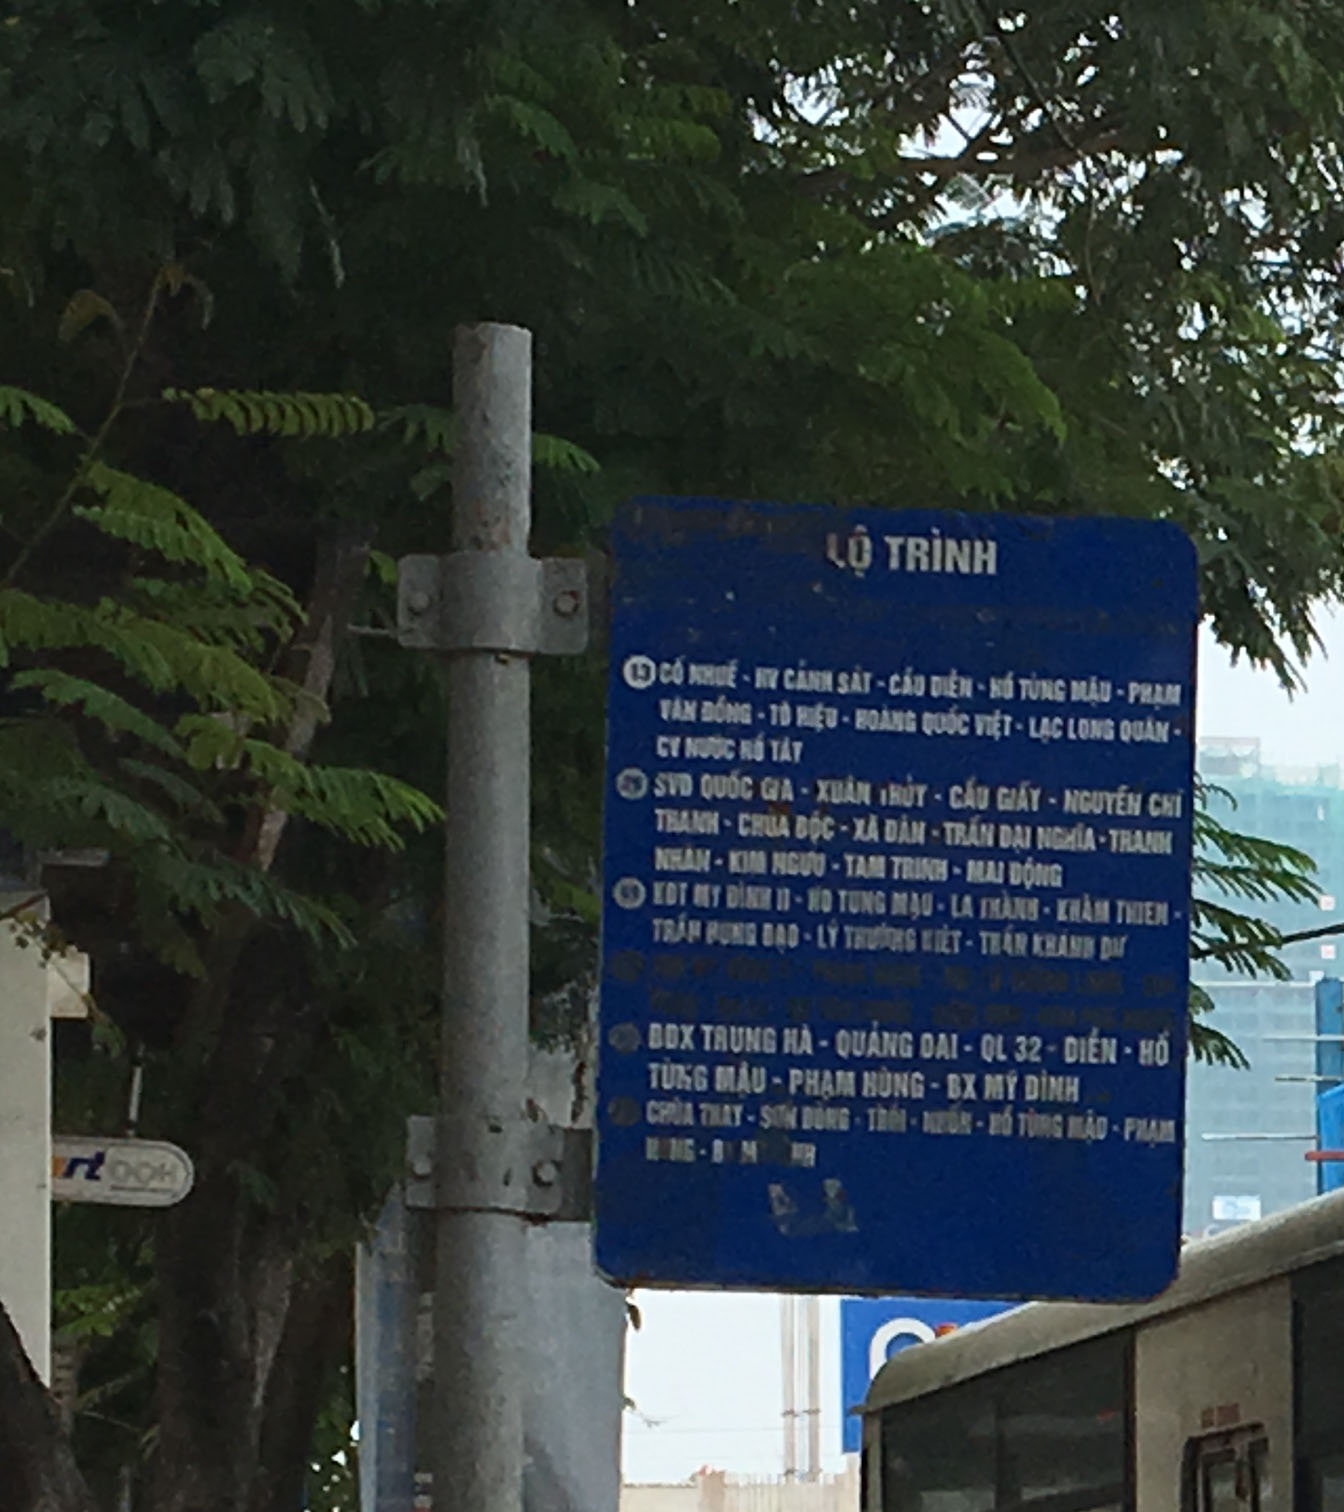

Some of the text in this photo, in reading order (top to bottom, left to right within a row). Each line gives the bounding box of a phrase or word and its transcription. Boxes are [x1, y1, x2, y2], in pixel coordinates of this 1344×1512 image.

[884, 528, 996, 575] TRÌNH
[1068, 718, 1114, 740] LONG
[701, 1024, 776, 1053] TRUNG
[981, 1034, 1007, 1062] QL
[1015, 1036, 1042, 1062] 32
[789, 1068, 855, 1100] PHẠM
